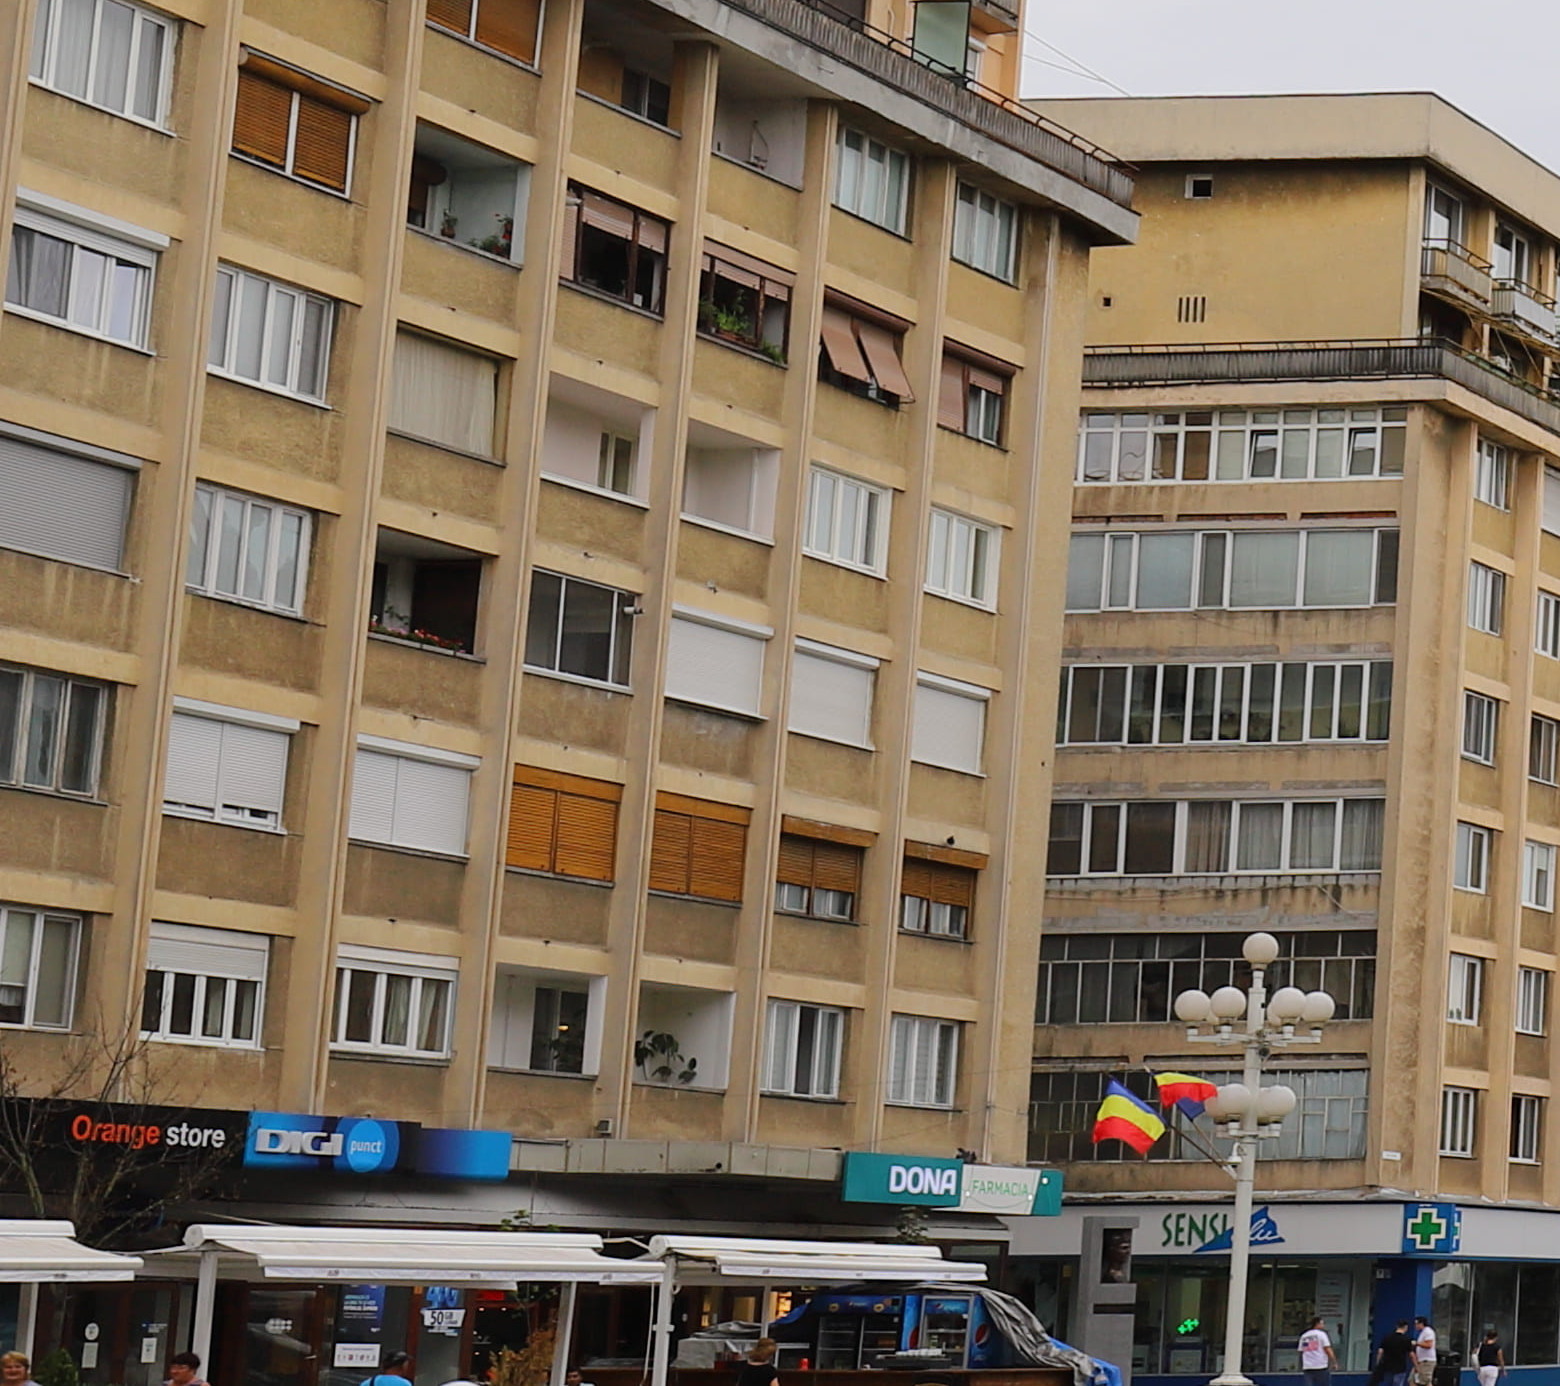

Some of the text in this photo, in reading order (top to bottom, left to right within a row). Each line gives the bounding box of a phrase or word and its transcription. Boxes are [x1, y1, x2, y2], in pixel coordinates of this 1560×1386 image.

[71, 1115, 226, 1150] Orange store
[255, 1128, 383, 1157] DIGI punct
[888, 1165, 958, 1196] DONA
[972, 1179, 1029, 1197] FARMACIA
[431, 1311, 444, 1325] 50
